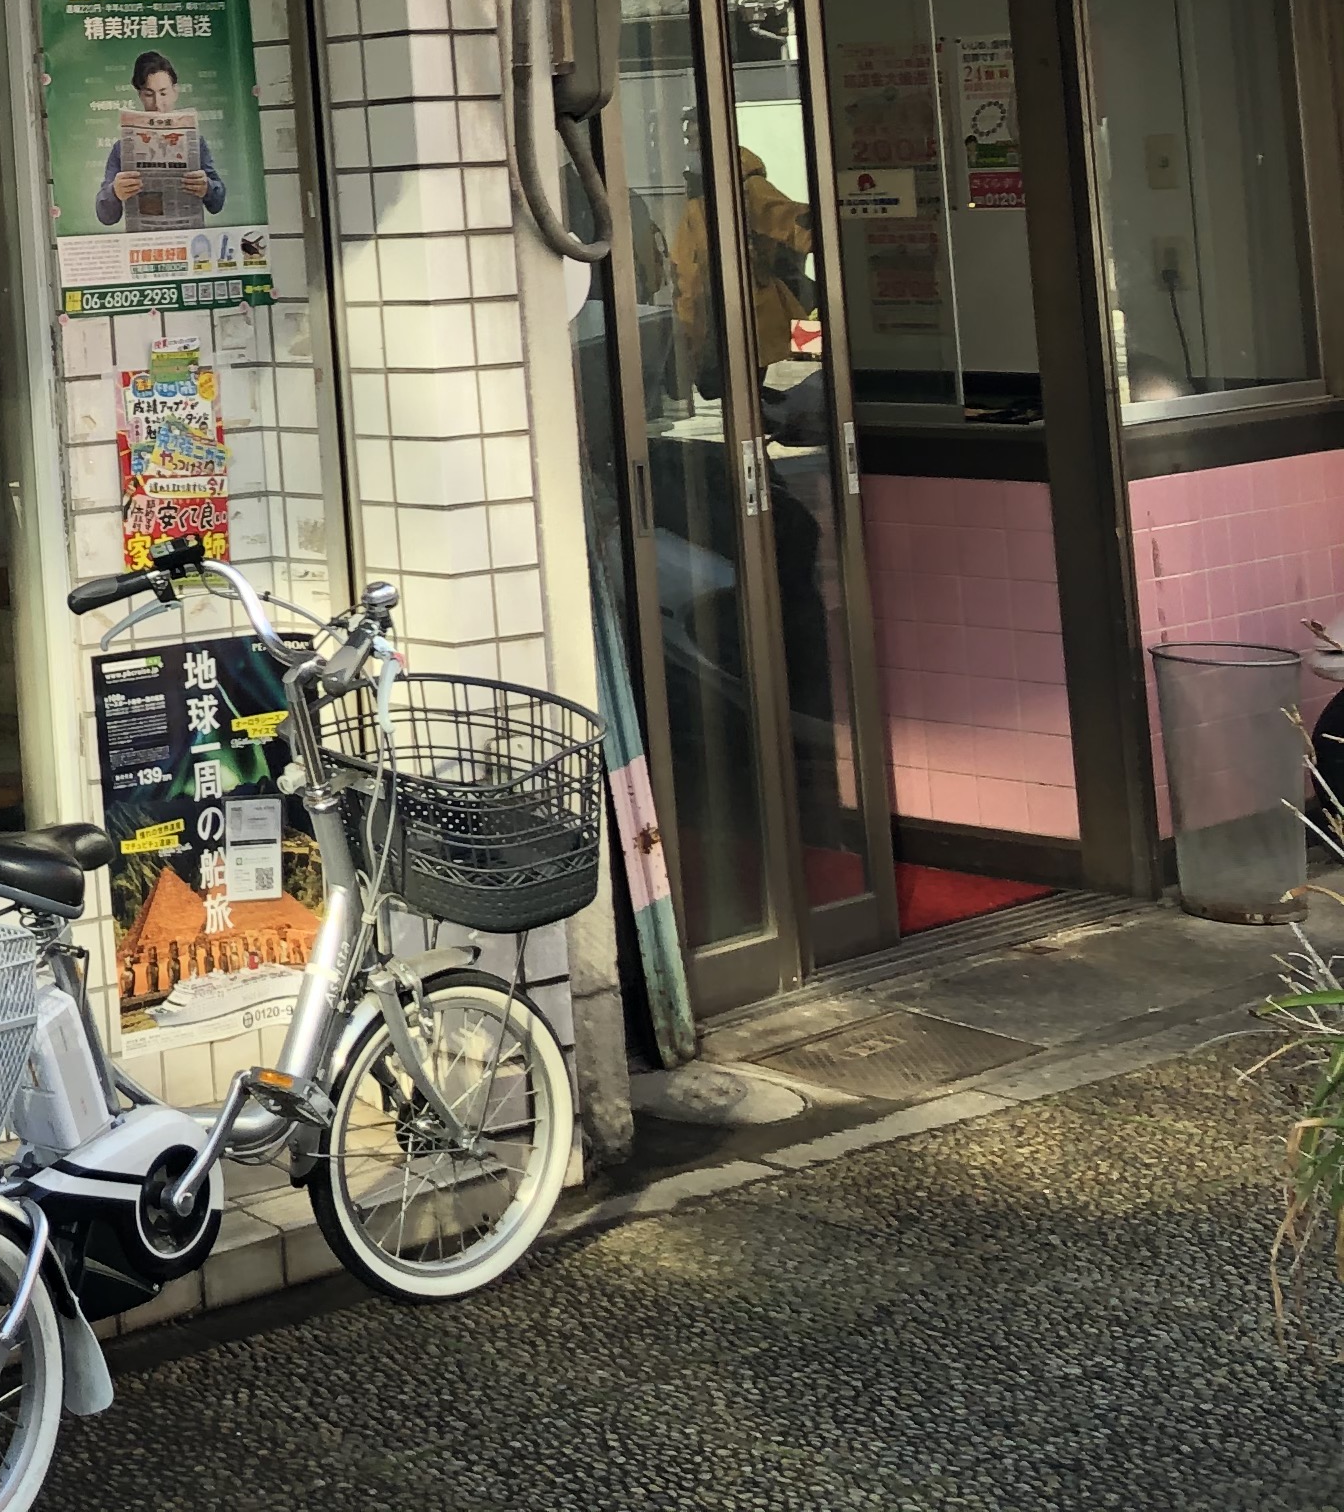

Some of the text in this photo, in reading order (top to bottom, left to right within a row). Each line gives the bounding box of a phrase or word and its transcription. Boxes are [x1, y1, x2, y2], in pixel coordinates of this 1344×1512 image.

[84, 15, 212, 40] 精美好禮大贈送
[82, 288, 178, 310] 06-6809-2939
[127, 531, 226, 572] 家師
[183, 649, 234, 934] 地球一周の船旅
